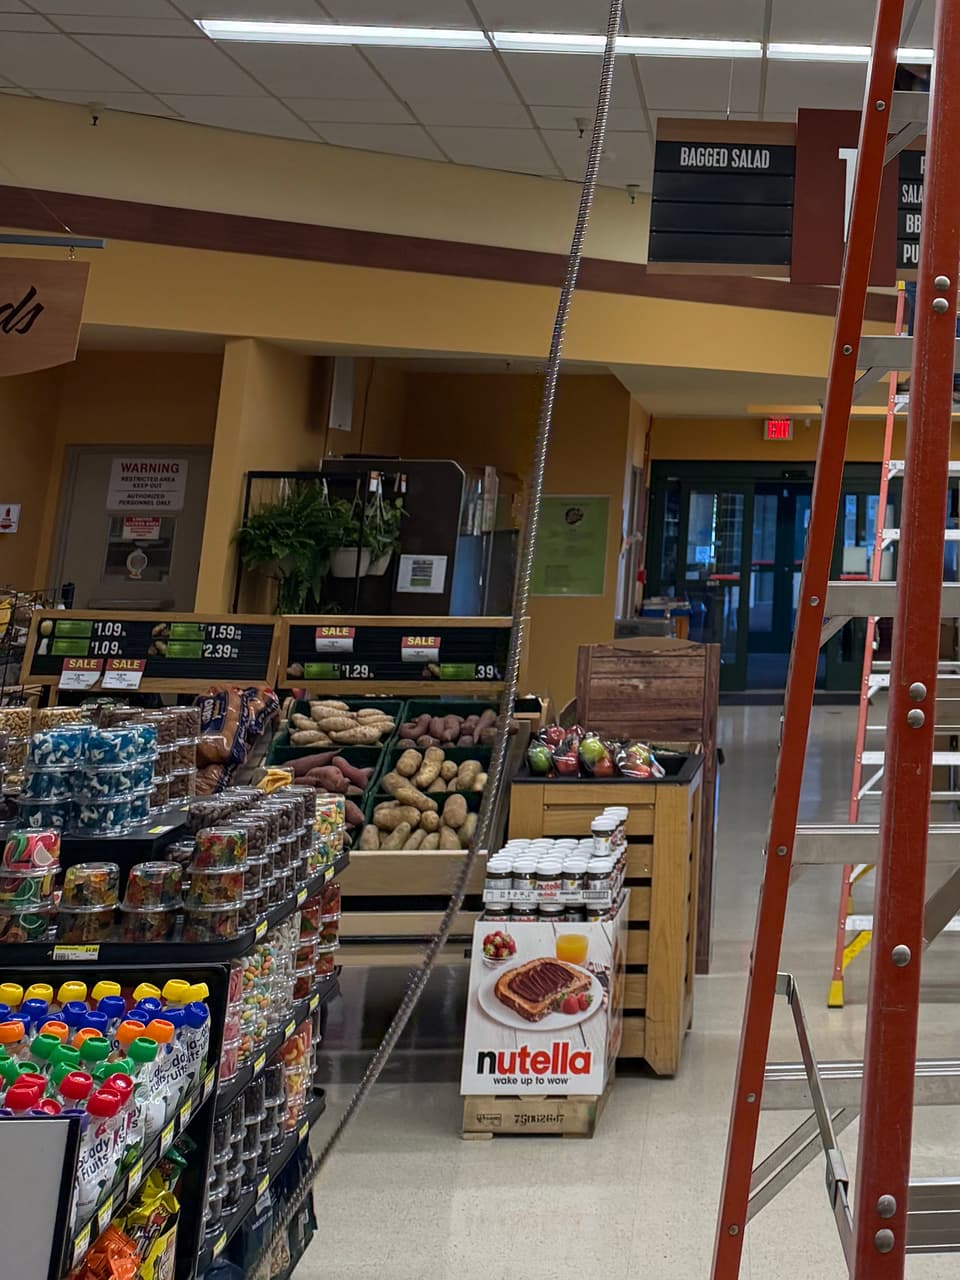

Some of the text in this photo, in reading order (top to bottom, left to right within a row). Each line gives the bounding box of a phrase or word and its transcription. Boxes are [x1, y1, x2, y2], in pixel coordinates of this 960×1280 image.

[680, 147, 770, 168] BAGGED SALAD
[902, 184, 924, 204] SALA
[905, 213, 921, 233] BB
[0, 285, 44, 335] ds
[767, 420, 790, 439] EXIT
[120, 462, 180, 474] WARNING
[321, 627, 350, 636] SALE
[407, 636, 435, 646] SALE
[68, 659, 97, 669] SALE
[112, 659, 140, 669] SALE
[477, 1042, 592, 1076] nutella
[493, 1076, 569, 1087] wake up to wow
